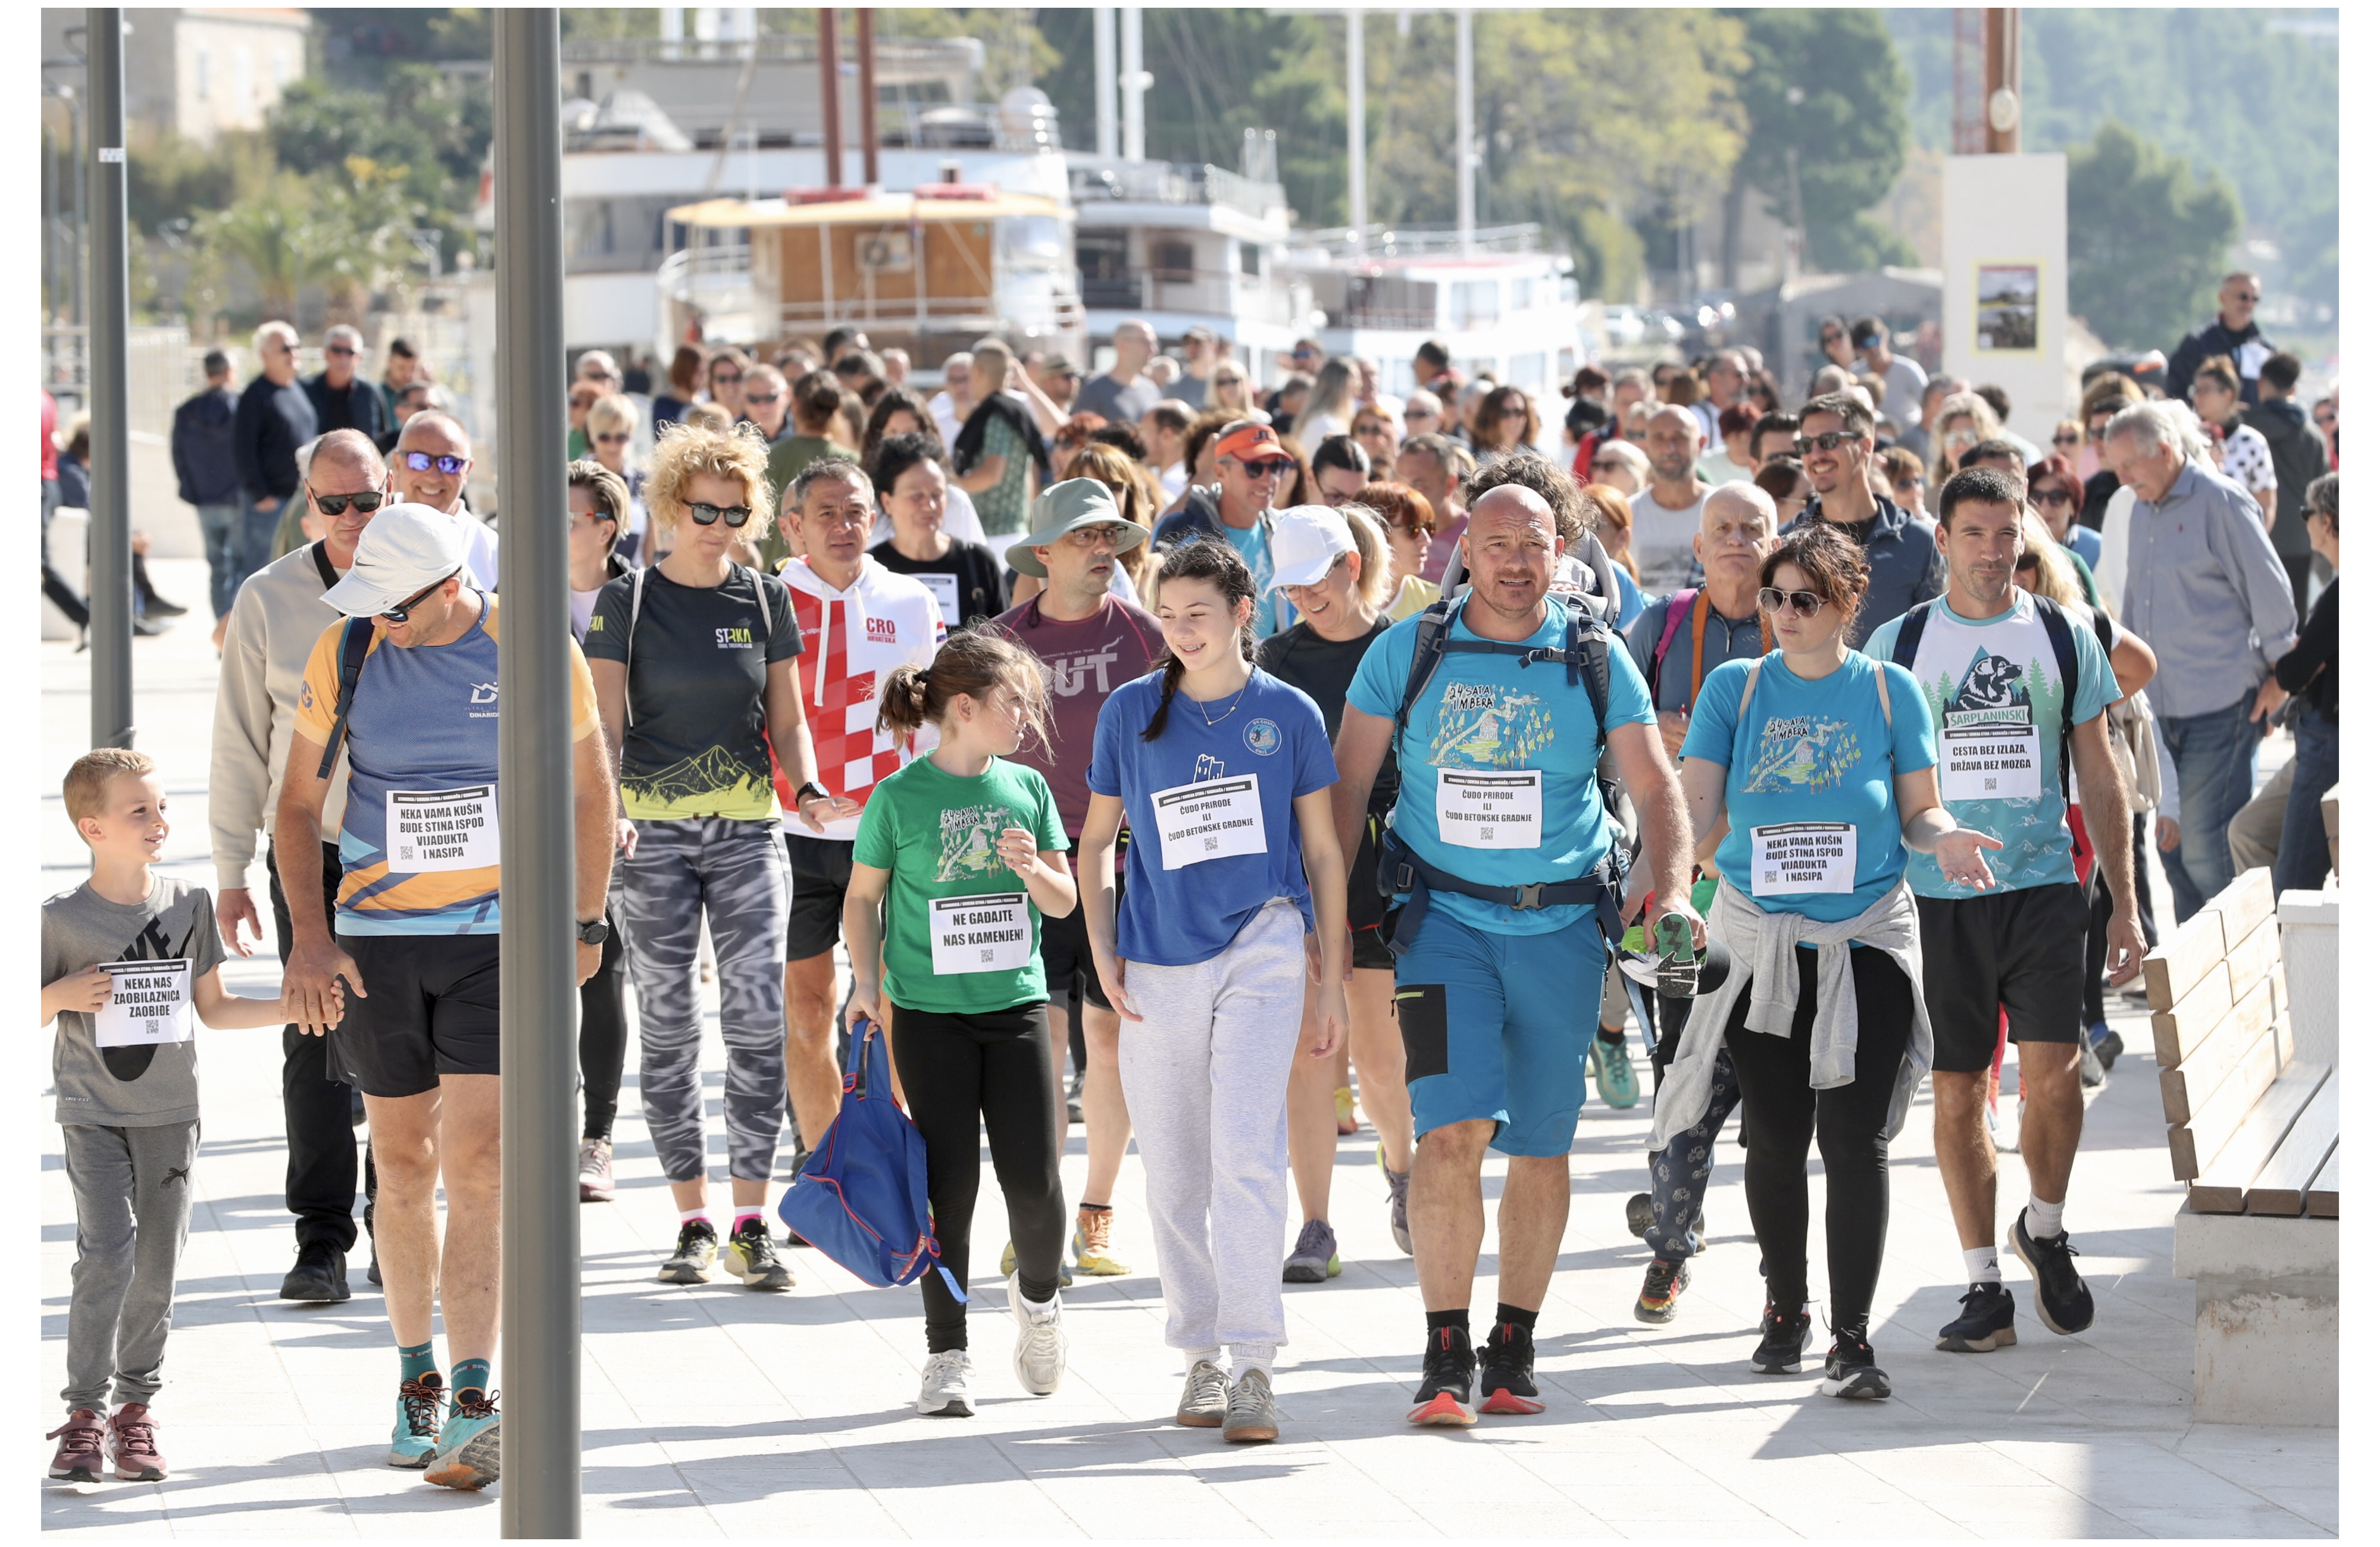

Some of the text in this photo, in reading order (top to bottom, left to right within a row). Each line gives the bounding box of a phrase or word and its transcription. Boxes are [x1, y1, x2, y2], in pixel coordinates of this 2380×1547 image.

[867, 617, 895, 634] CRO
[1450, 684, 1490, 700] 24 SATA
[1769, 716, 1805, 732] 24 SATA
[1950, 709, 2025, 726] ŠARPLANINSKI
[1953, 744, 2027, 756] CESTA BEZ IZLAZA,
[1951, 759, 2031, 771] DRŽAVA BEZ MOZGA
[1462, 789, 1513, 800] ČUDO PRIRODE
[401, 802, 482, 819] NEKA VAMA KUŠIN
[1180, 798, 1231, 815] ČUDO PRIRODE
[945, 807, 974, 823] 24 SATA
[1202, 813, 1211, 821] ILI
[1446, 810, 1462, 820] ČUDO
[1464, 813, 1499, 822] BETONSKE
[400, 817, 484, 833] BUDE STINA ISPOD
[1168, 818, 1254, 841] ČUDO BETONSKE GRADNJE
[417, 832, 468, 846] VIJADUKTA
[1767, 834, 1842, 850] NEKA VAMA KUŠIN
[423, 847, 464, 859] I NASIPA
[1766, 847, 1843, 860] BUDE STINA ISPOD
[1781, 860, 1827, 870] VIJADUKTA
[1786, 872, 1822, 882] I NASIPA
[953, 910, 1013, 926] NE GAĐAJTE
[943, 928, 1024, 947] NAS KAMENJEN!
[125, 976, 172, 990] NEKA NAS
[114, 990, 180, 1004] ZAOBILAZNICA
[129, 1005, 170, 1017] ZAOBIĐE
